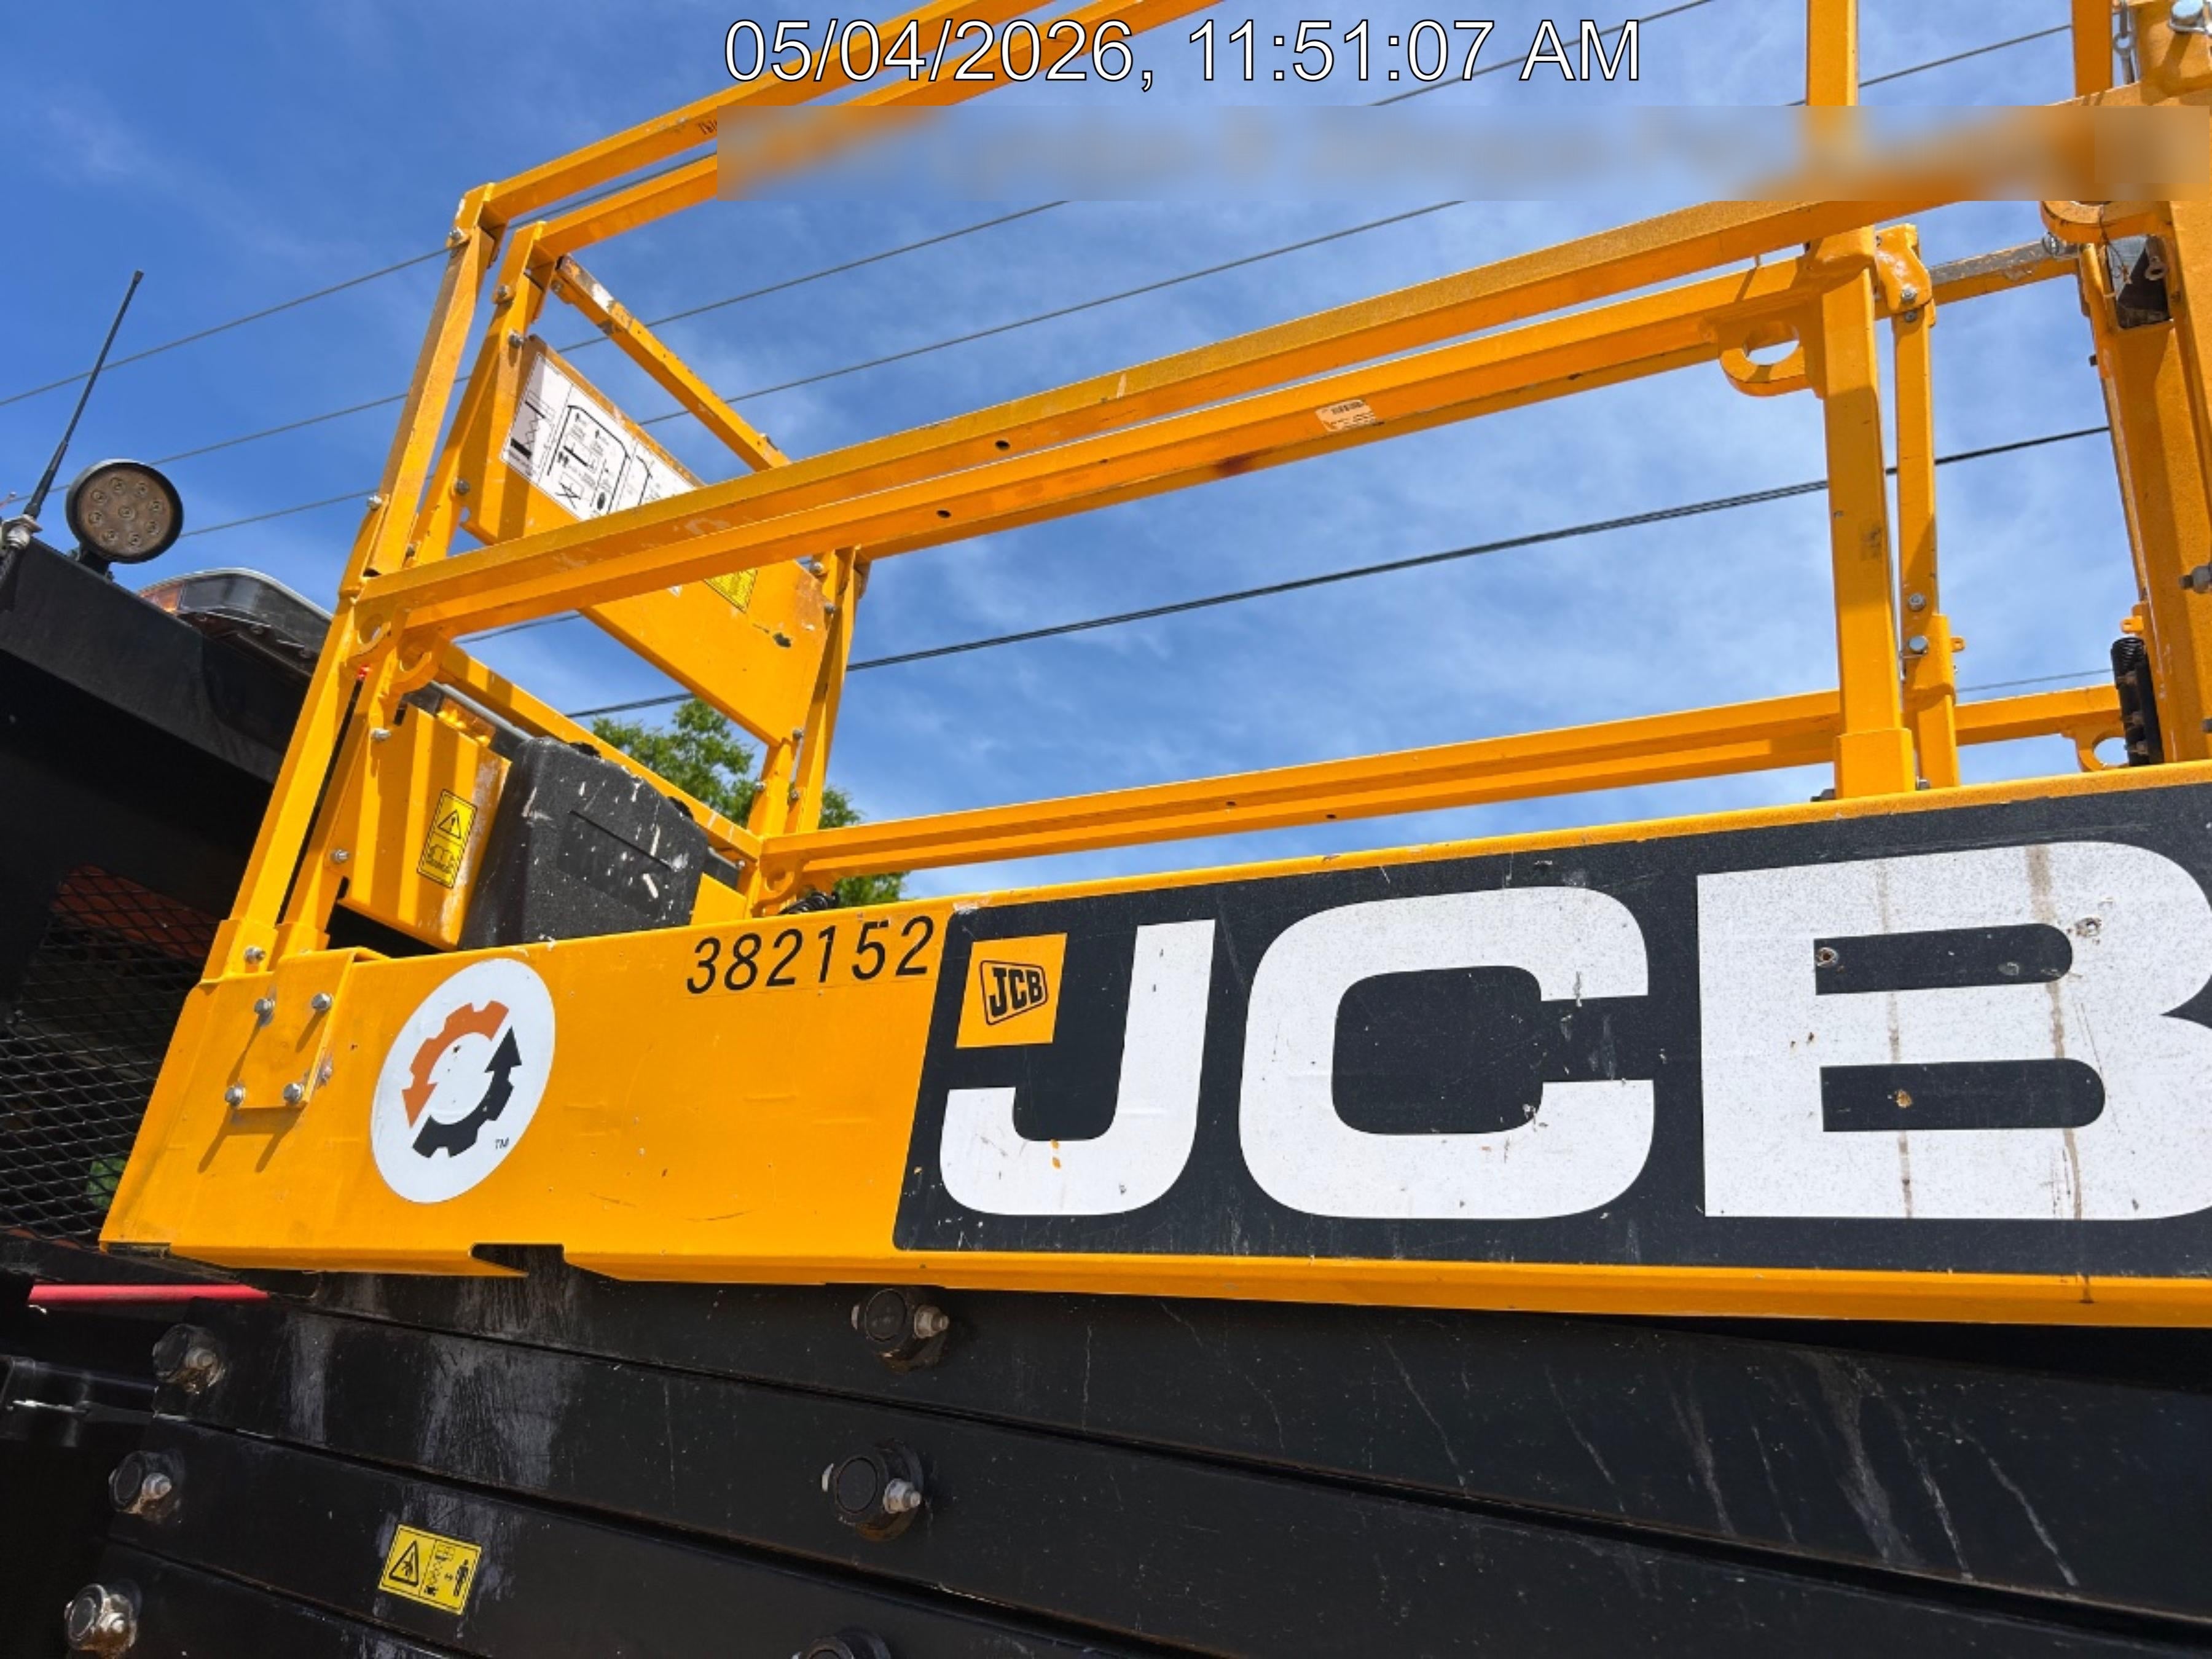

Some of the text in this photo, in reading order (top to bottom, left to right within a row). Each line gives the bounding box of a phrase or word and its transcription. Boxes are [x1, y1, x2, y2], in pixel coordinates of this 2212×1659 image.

[686, 915, 935, 994] 382152
[988, 967, 1043, 1018] JCB
[938, 841, 2212, 1221] JCB
